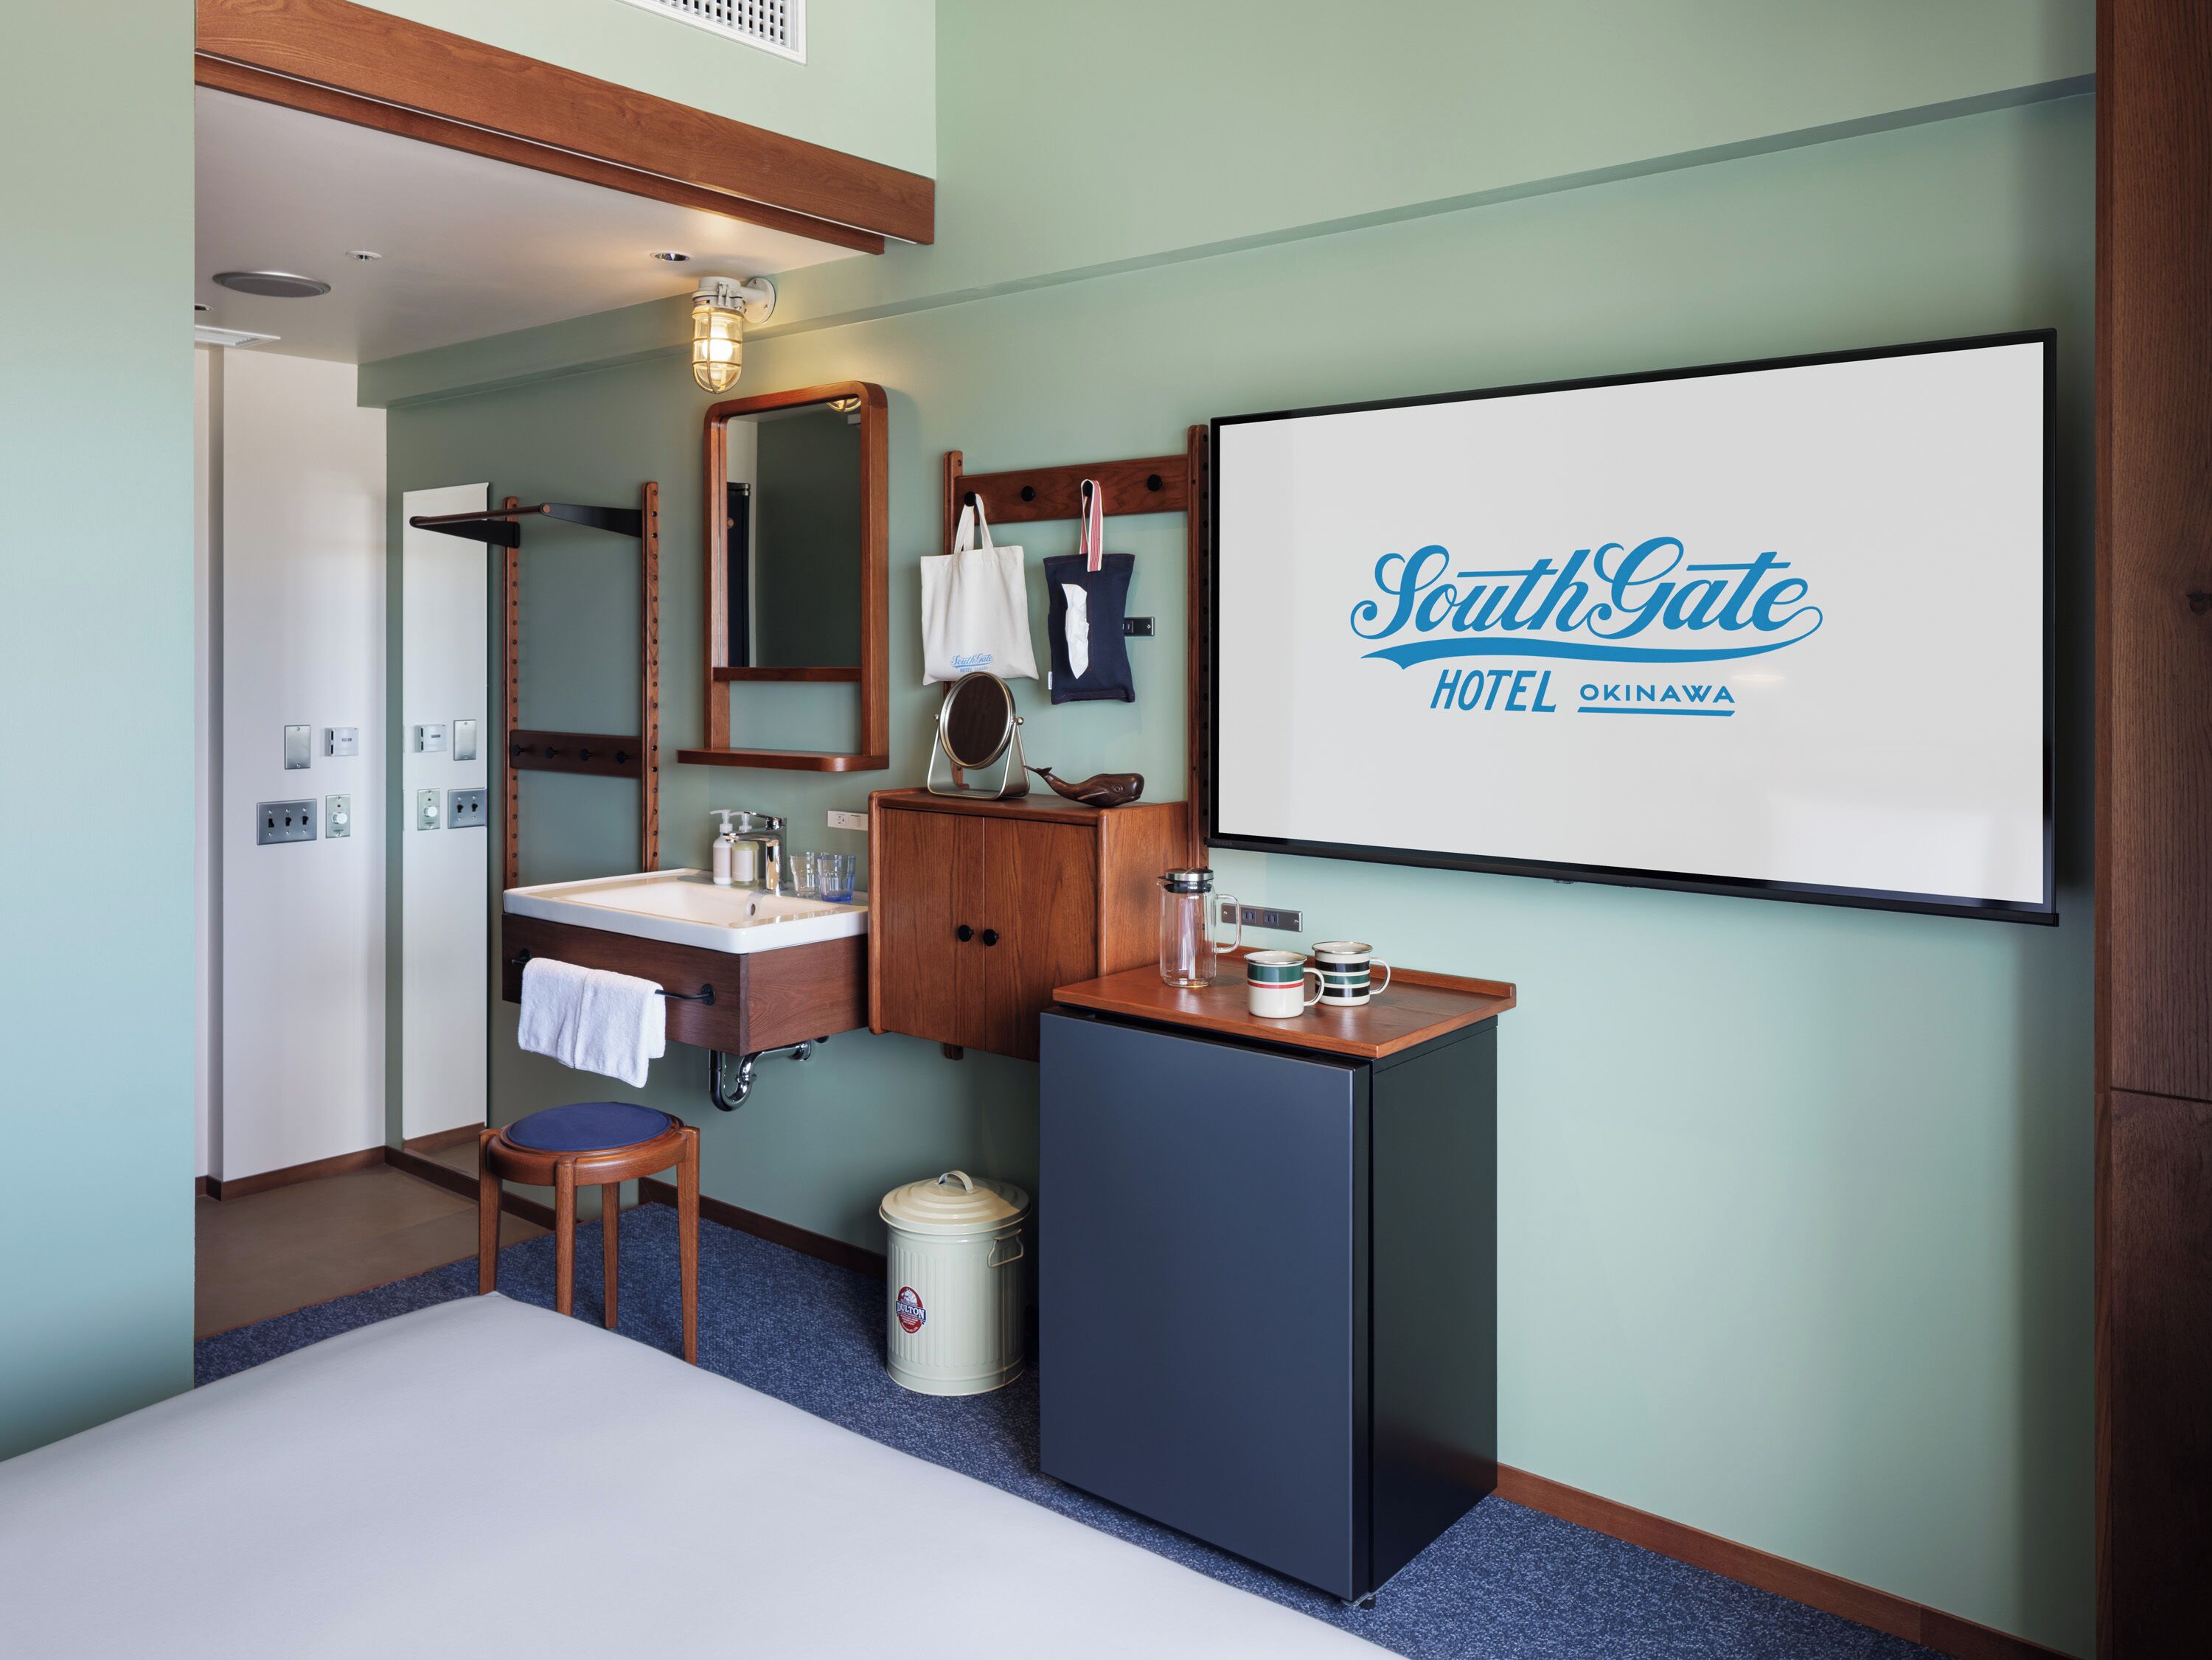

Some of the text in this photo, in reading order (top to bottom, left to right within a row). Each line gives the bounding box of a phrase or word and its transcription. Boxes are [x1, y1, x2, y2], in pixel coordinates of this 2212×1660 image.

[1429, 669, 1735, 713] HOTEL OKINAWA
[897, 1302, 925, 1319] DULTON
